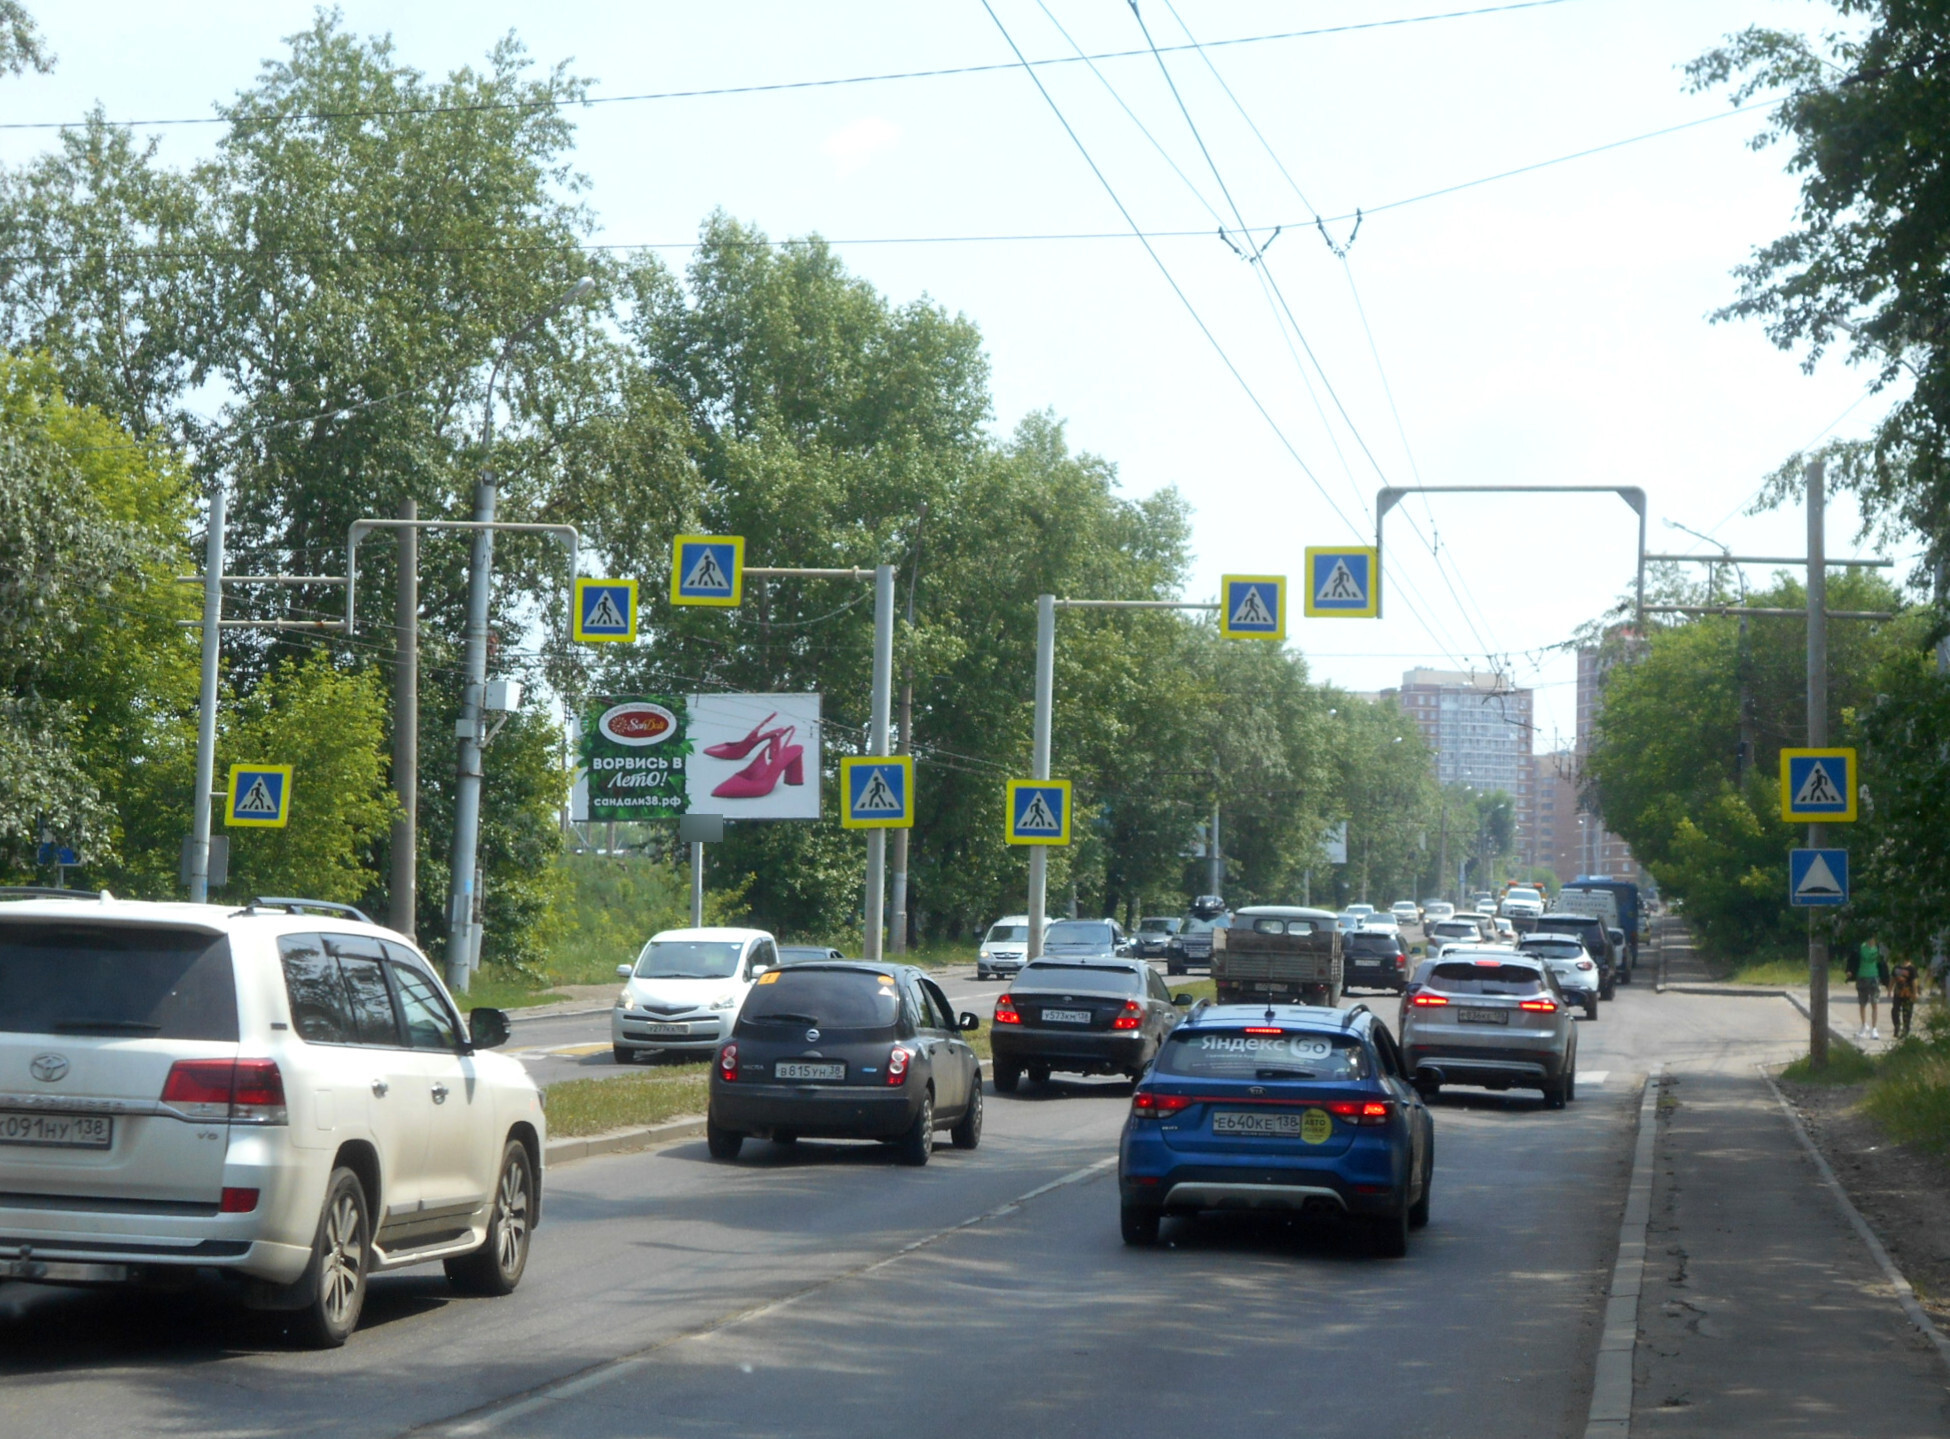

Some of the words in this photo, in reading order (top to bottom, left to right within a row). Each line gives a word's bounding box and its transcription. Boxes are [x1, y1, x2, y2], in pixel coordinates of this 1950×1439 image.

[593, 758, 668, 769] ВОРВИСЬ
[673, 757, 682, 769] В
[594, 796, 682, 807] сандали38.рф
[1201, 1035, 1285, 1052] Яндекс
[1298, 1038, 1326, 1055] Go
[781, 1065, 826, 1077] В815УН
[829, 1066, 840, 1075] 38
[74, 1119, 104, 1135] 138
[1217, 1114, 1273, 1130] Е640КЕ
[1277, 1116, 1297, 1127] 138
